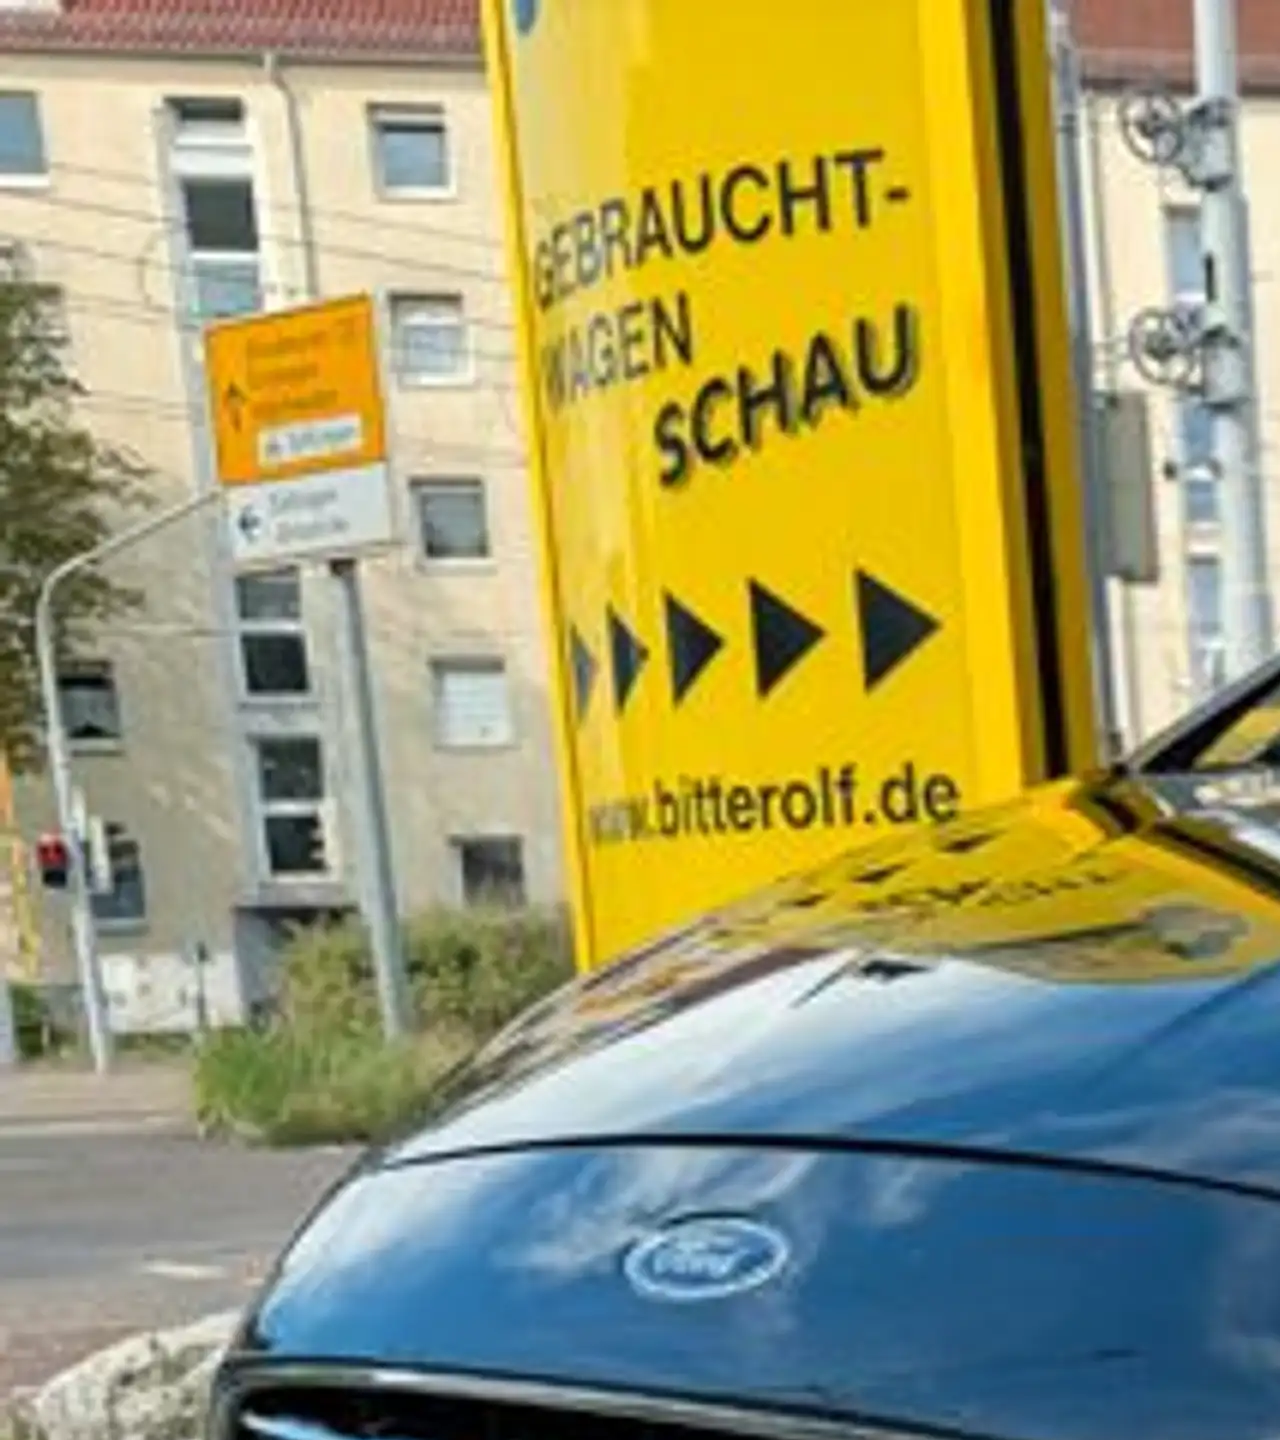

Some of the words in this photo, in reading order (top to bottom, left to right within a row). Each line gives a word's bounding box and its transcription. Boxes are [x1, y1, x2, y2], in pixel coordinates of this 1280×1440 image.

[533, 148, 911, 313] GEBRAUCHT-
[540, 290, 693, 413] WAGEN
[653, 302, 918, 489] SCHAU
[590, 761, 961, 843] www.bitterolf.de
